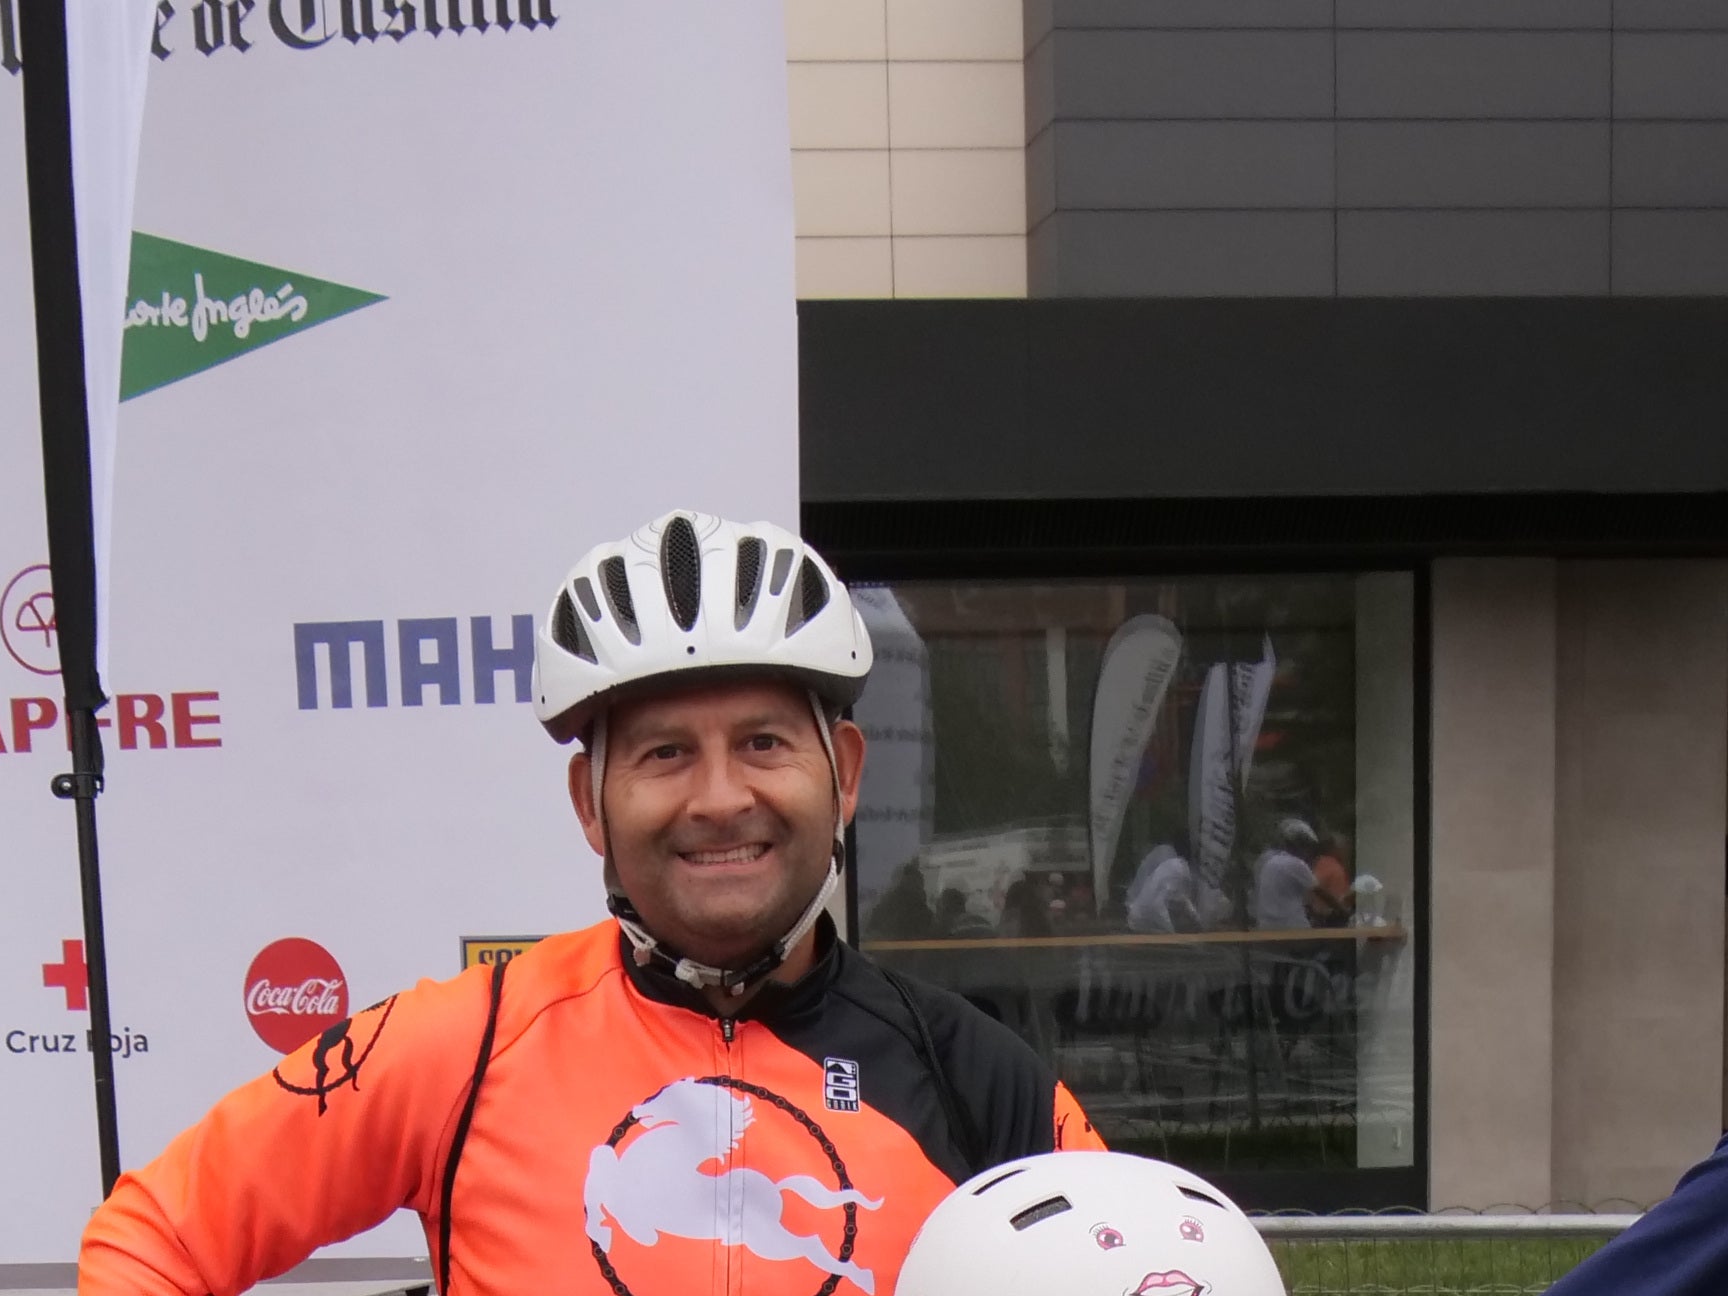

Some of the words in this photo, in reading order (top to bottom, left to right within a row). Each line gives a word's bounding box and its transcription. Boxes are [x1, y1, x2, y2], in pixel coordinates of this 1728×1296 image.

[294, 614, 535, 710] MAH
[247, 976, 340, 1017] Coca-Cola
[5, 1030, 77, 1055] Cruz
[90, 1029, 150, 1062] oja
